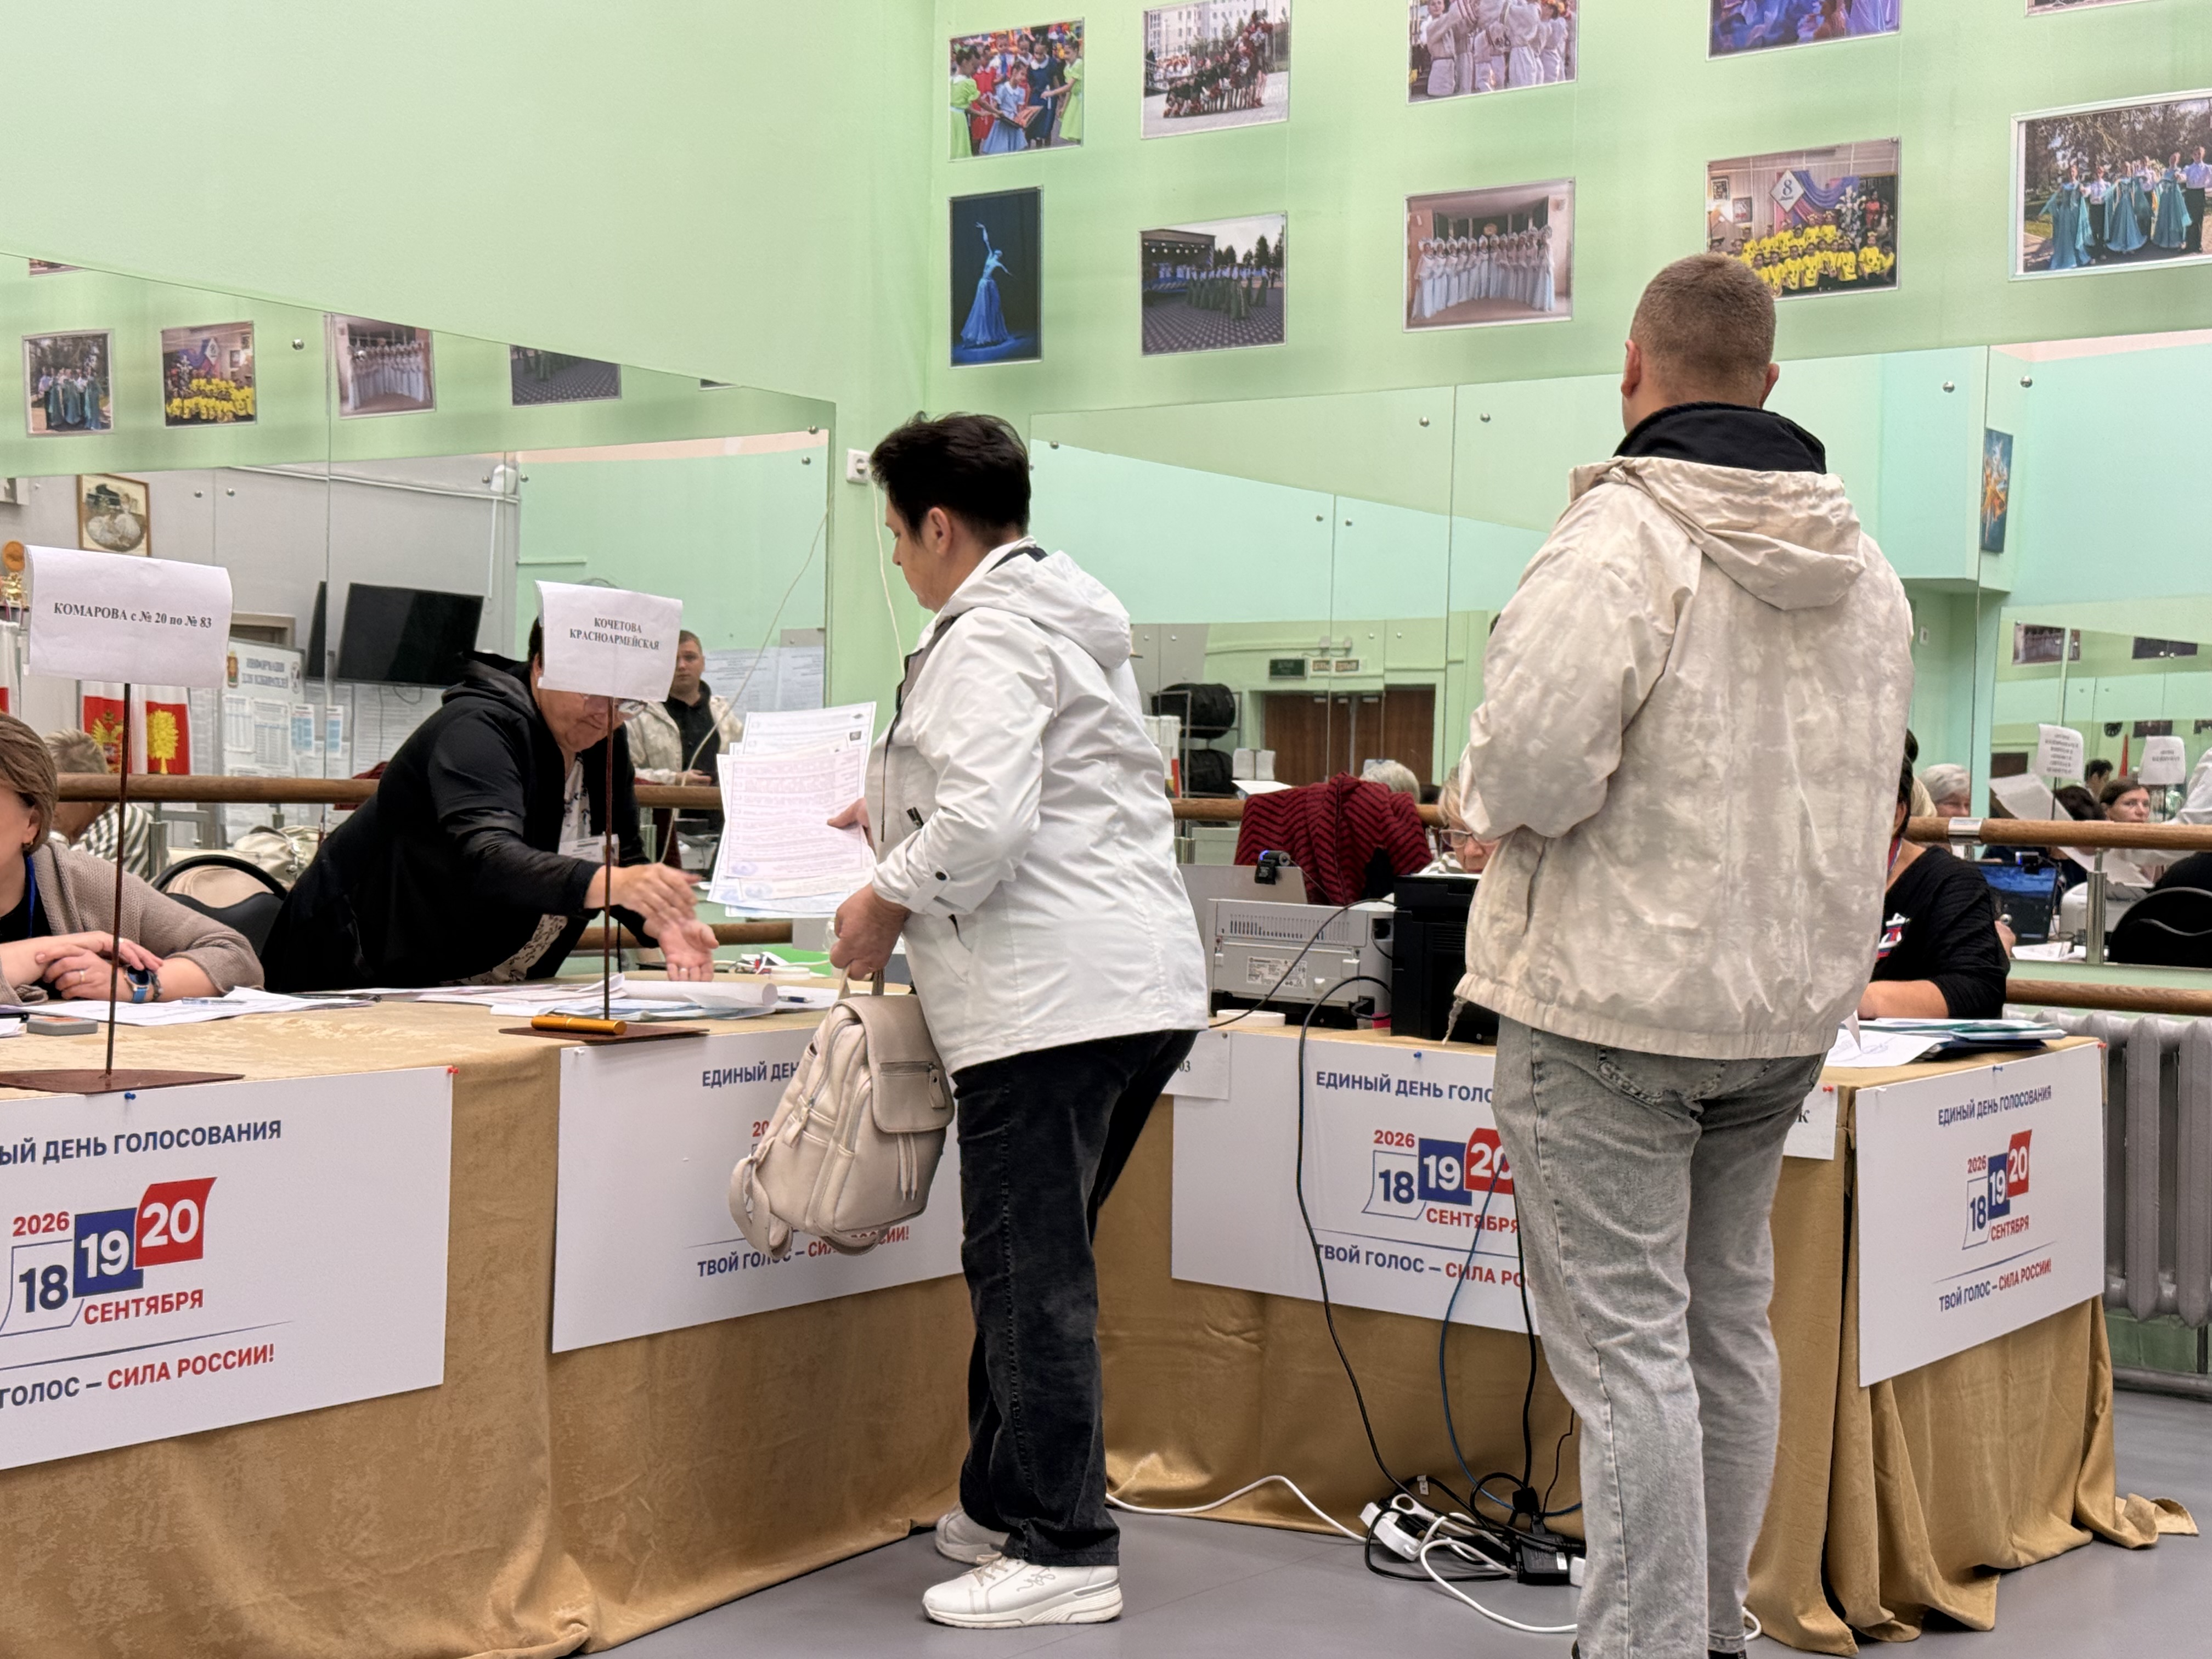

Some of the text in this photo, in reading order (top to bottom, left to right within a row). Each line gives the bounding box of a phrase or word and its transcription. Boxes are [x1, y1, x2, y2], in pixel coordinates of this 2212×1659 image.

[1782, 179, 1792, 196] 8
[53, 602, 212, 628] КОМАРОВА с № 20 по № 83
[594, 617, 642, 633] КОЧЕТОВА
[569, 628, 659, 650] КРАСНОАРМЕЙСКАЯ
[702, 1060, 800, 1088] ЕДИНЫЙ ДЕН
[1316, 1071, 1391, 1093] ЕДИНЫЙ
[1395, 1079, 1443, 1098] ДЕНЬ
[1938, 1085, 2051, 1127] ЕДИНЫЙ ДЕНЬ ГОЛОСОВАНИЯ
[43, 1137, 108, 1165] ДЕНЬ
[114, 1120, 281, 1154] ГОЛОСОВАНИЯ
[752, 1120, 770, 1137] 20
[1373, 1130, 1415, 1148] 2026
[1967, 1155, 1987, 1173] 2026
[1379, 1169, 1414, 1204] 18
[1424, 1155, 1461, 1190] 19
[1970, 1146, 2028, 1232] 18 19 20
[13, 1211, 70, 1237] 2026
[1426, 1207, 1519, 1234] СЕНТЯБРЯ
[1990, 1214, 2029, 1242] СЕНТЯБРЯ
[19, 1199, 200, 1313] 18 19 20
[697, 1250, 739, 1277] ТВОЙ
[808, 1240, 836, 1257] СИ
[1316, 1244, 1360, 1264] ТВОЙ
[1365, 1250, 1424, 1273] ГОЛОС
[1446, 1262, 1497, 1284] СИЛА
[1939, 1285, 1962, 1312] ТВОЙ
[1963, 1280, 1991, 1304] ГОЛОС
[1999, 1270, 2019, 1291] СИЛА
[2021, 1257, 2051, 1283] РОССИИ!
[84, 1289, 204, 1325] СЕНТЯБРЯ
[0, 1376, 80, 1409] ГОЛОС
[108, 1361, 171, 1390] СИЛА
[178, 1344, 274, 1379] РОССИИ!
